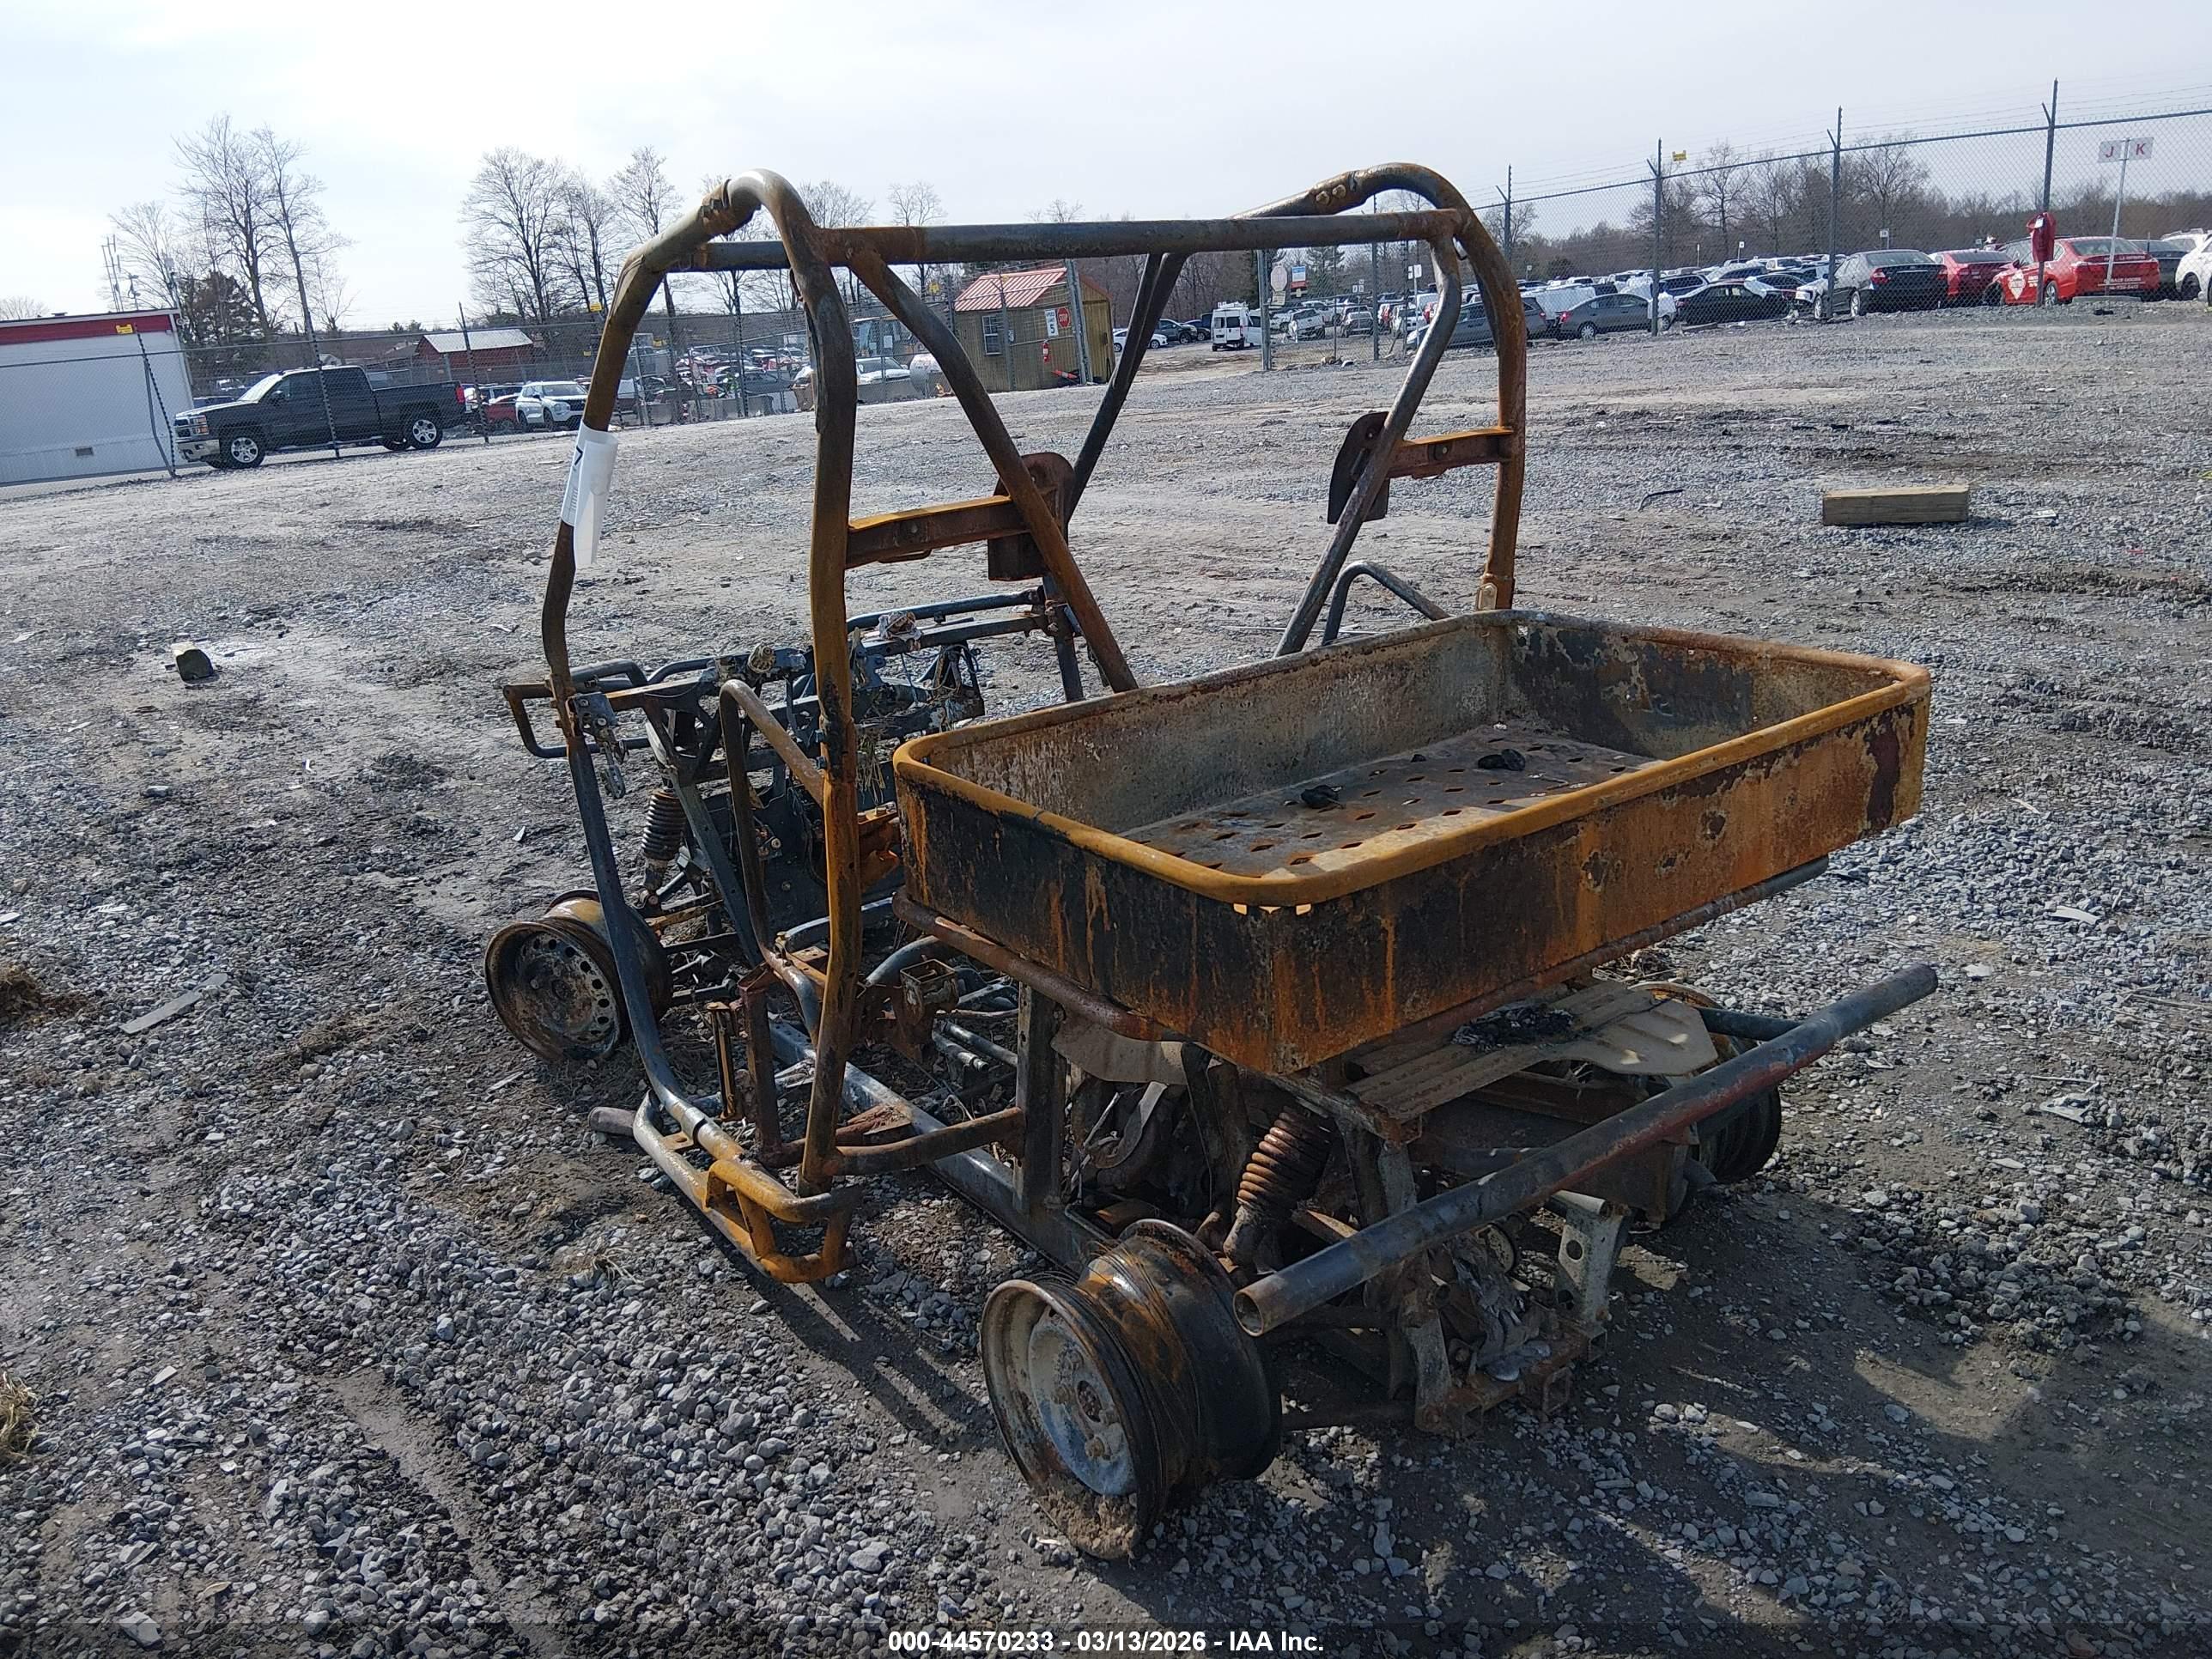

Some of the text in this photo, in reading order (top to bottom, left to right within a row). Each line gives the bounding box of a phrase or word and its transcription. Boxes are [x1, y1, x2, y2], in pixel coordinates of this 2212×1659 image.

[2105, 146, 2114, 158] J
[2136, 143, 2147, 155] K
[1050, 324, 1055, 334] 5
